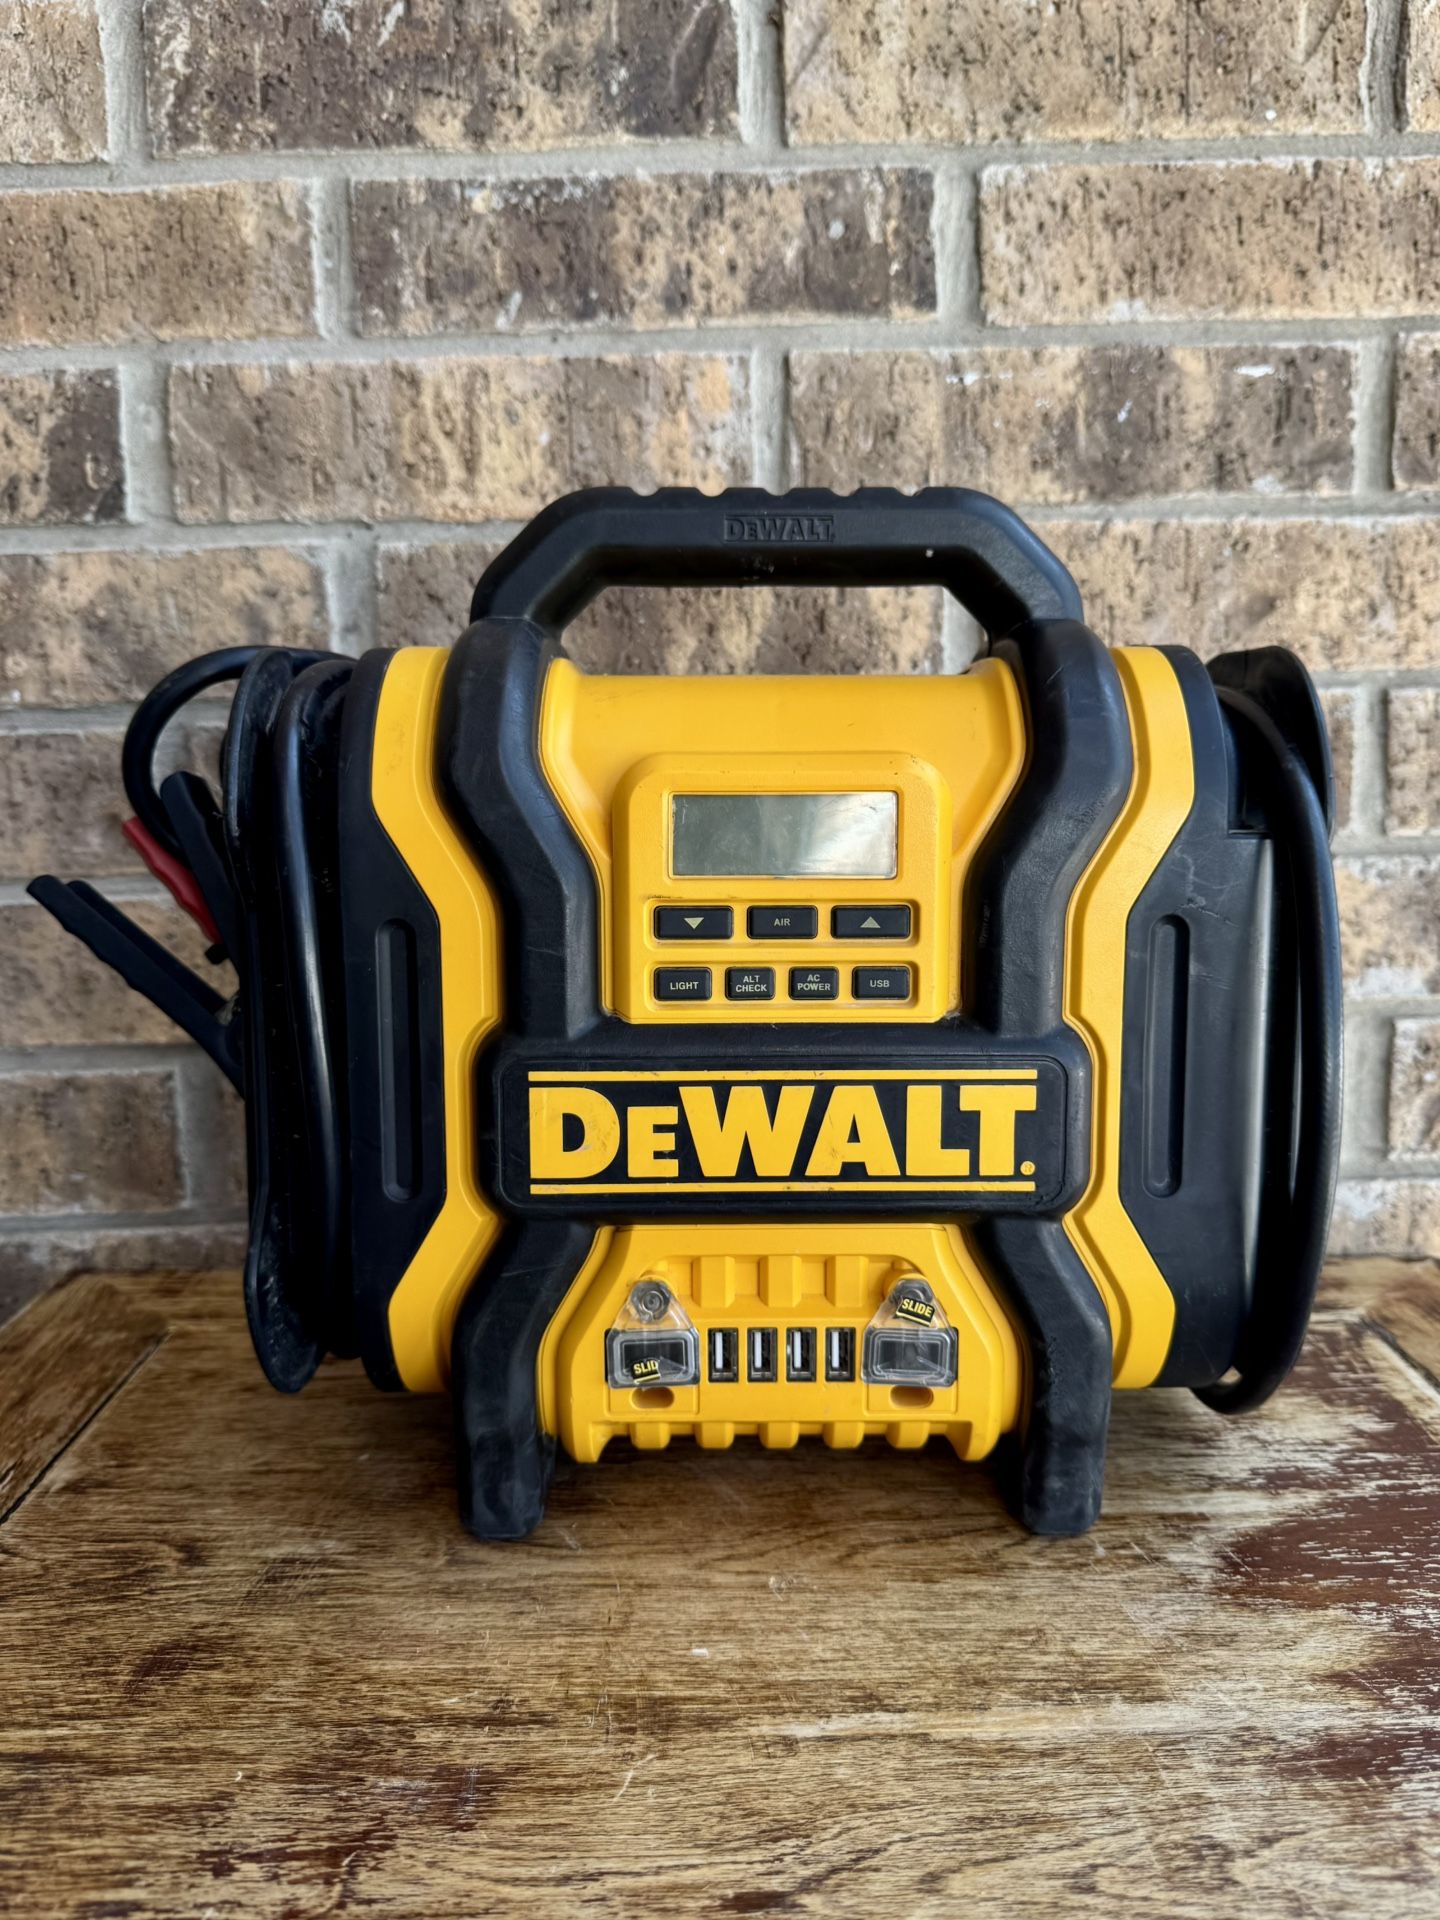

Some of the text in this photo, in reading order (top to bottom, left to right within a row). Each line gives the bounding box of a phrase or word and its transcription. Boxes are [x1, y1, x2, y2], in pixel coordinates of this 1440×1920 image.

[723, 518, 834, 541] DEWALT
[773, 917, 791, 927] AIR
[743, 975, 759, 984] ALT
[807, 974, 821, 982] AC
[670, 981, 699, 991] LIGHT
[735, 983, 768, 993] CHECK
[797, 982, 831, 992] POWER
[870, 979, 890, 989] USB
[529, 1085, 1037, 1178] DEWALT
[901, 1298, 933, 1318] SLIDE
[633, 1360, 659, 1375] SLID
